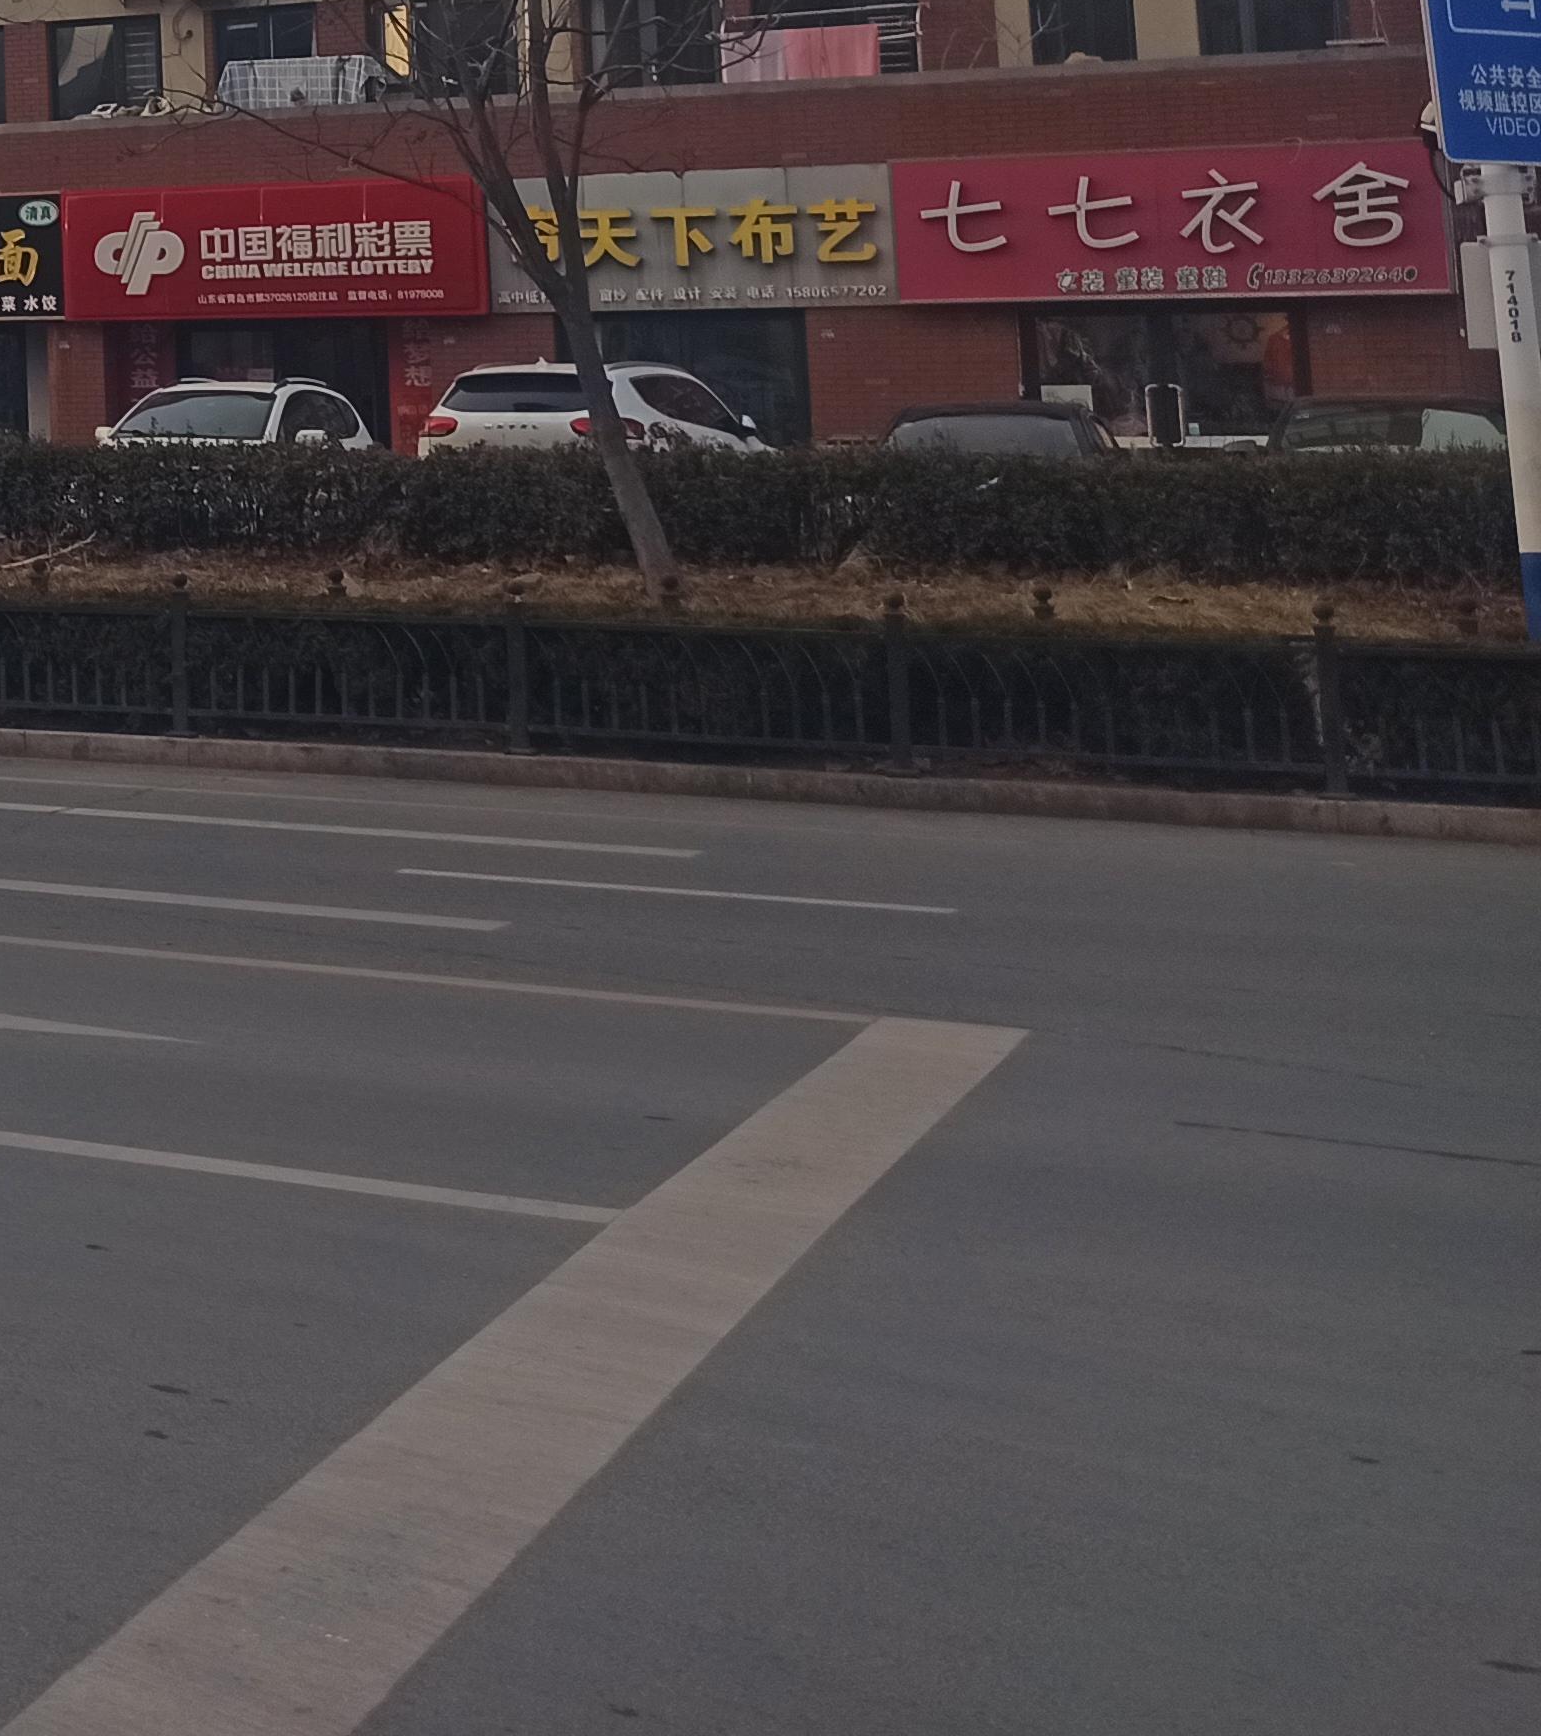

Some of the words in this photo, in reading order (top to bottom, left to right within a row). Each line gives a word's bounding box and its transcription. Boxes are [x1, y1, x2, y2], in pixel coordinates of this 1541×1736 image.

[1485, 116, 1541, 137] VIDEO
[25, 204, 53, 221] 清真
[920, 161, 1409, 253] 七七衣舍
[199, 220, 433, 262] 中国福利彩票
[201, 262, 262, 280] CHINA
[263, 261, 349, 278] WELFARE
[351, 259, 433, 276] LOTTERY
[1056, 270, 1105, 293] 女装
[24, 294, 58, 312] 水饺
